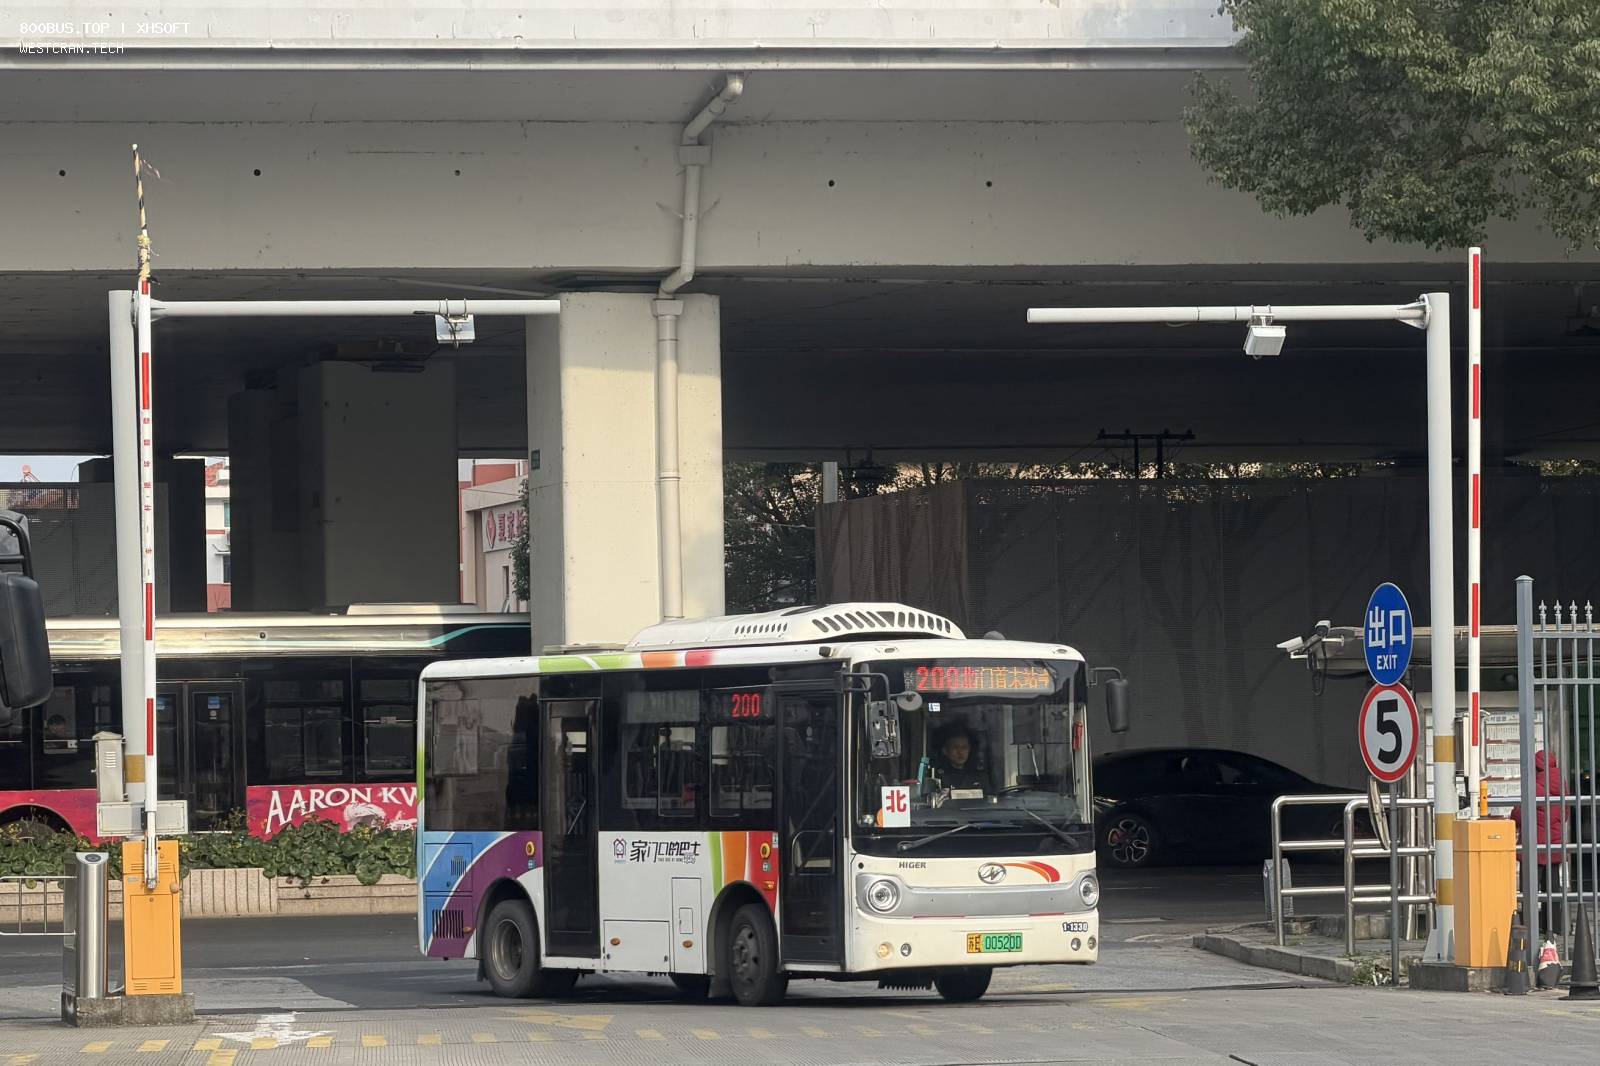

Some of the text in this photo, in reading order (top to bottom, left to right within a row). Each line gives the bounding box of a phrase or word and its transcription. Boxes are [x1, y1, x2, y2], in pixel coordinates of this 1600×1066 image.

[1368, 606, 1406, 648] 出口
[1376, 654, 1398, 670] EXIT
[732, 694, 760, 717] 200
[1377, 699, 1403, 764] 5
[265, 788, 372, 834] AARON
[886, 790, 907, 812] 北
[630, 840, 701, 863] 家门口的巴士
